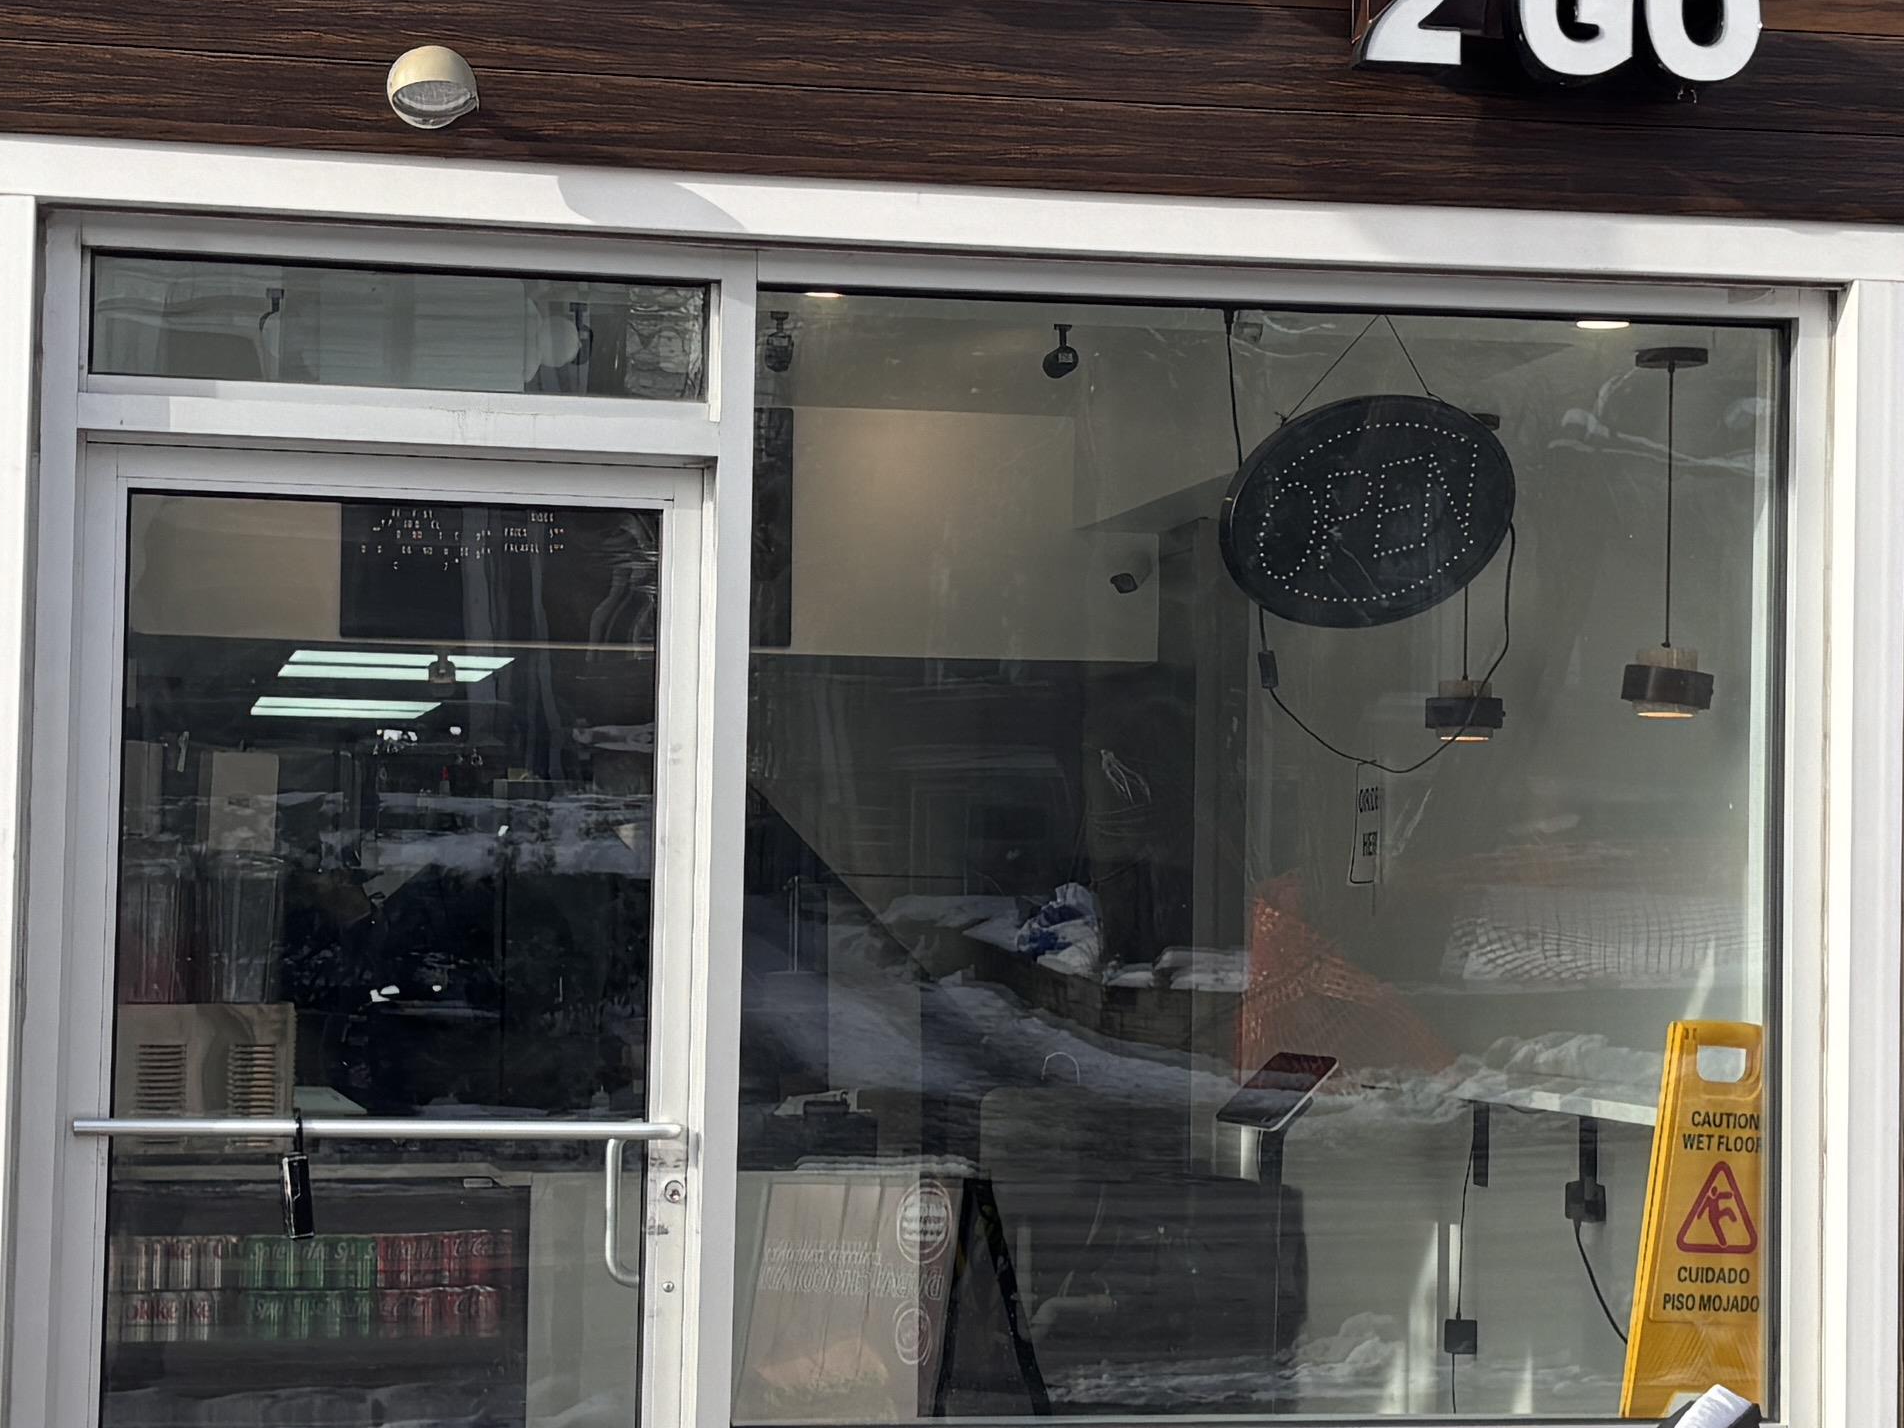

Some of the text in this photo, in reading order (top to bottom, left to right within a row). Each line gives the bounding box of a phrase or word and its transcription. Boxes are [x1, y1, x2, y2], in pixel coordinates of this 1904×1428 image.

[1258, 441, 1479, 580] OPEN
[1691, 1111, 1760, 1130] CAUTION
[1683, 1133, 1714, 1151] WET
[1677, 1266, 1751, 1284] CUIDADO
[1663, 1293, 1760, 1313] PISO MOJADO
